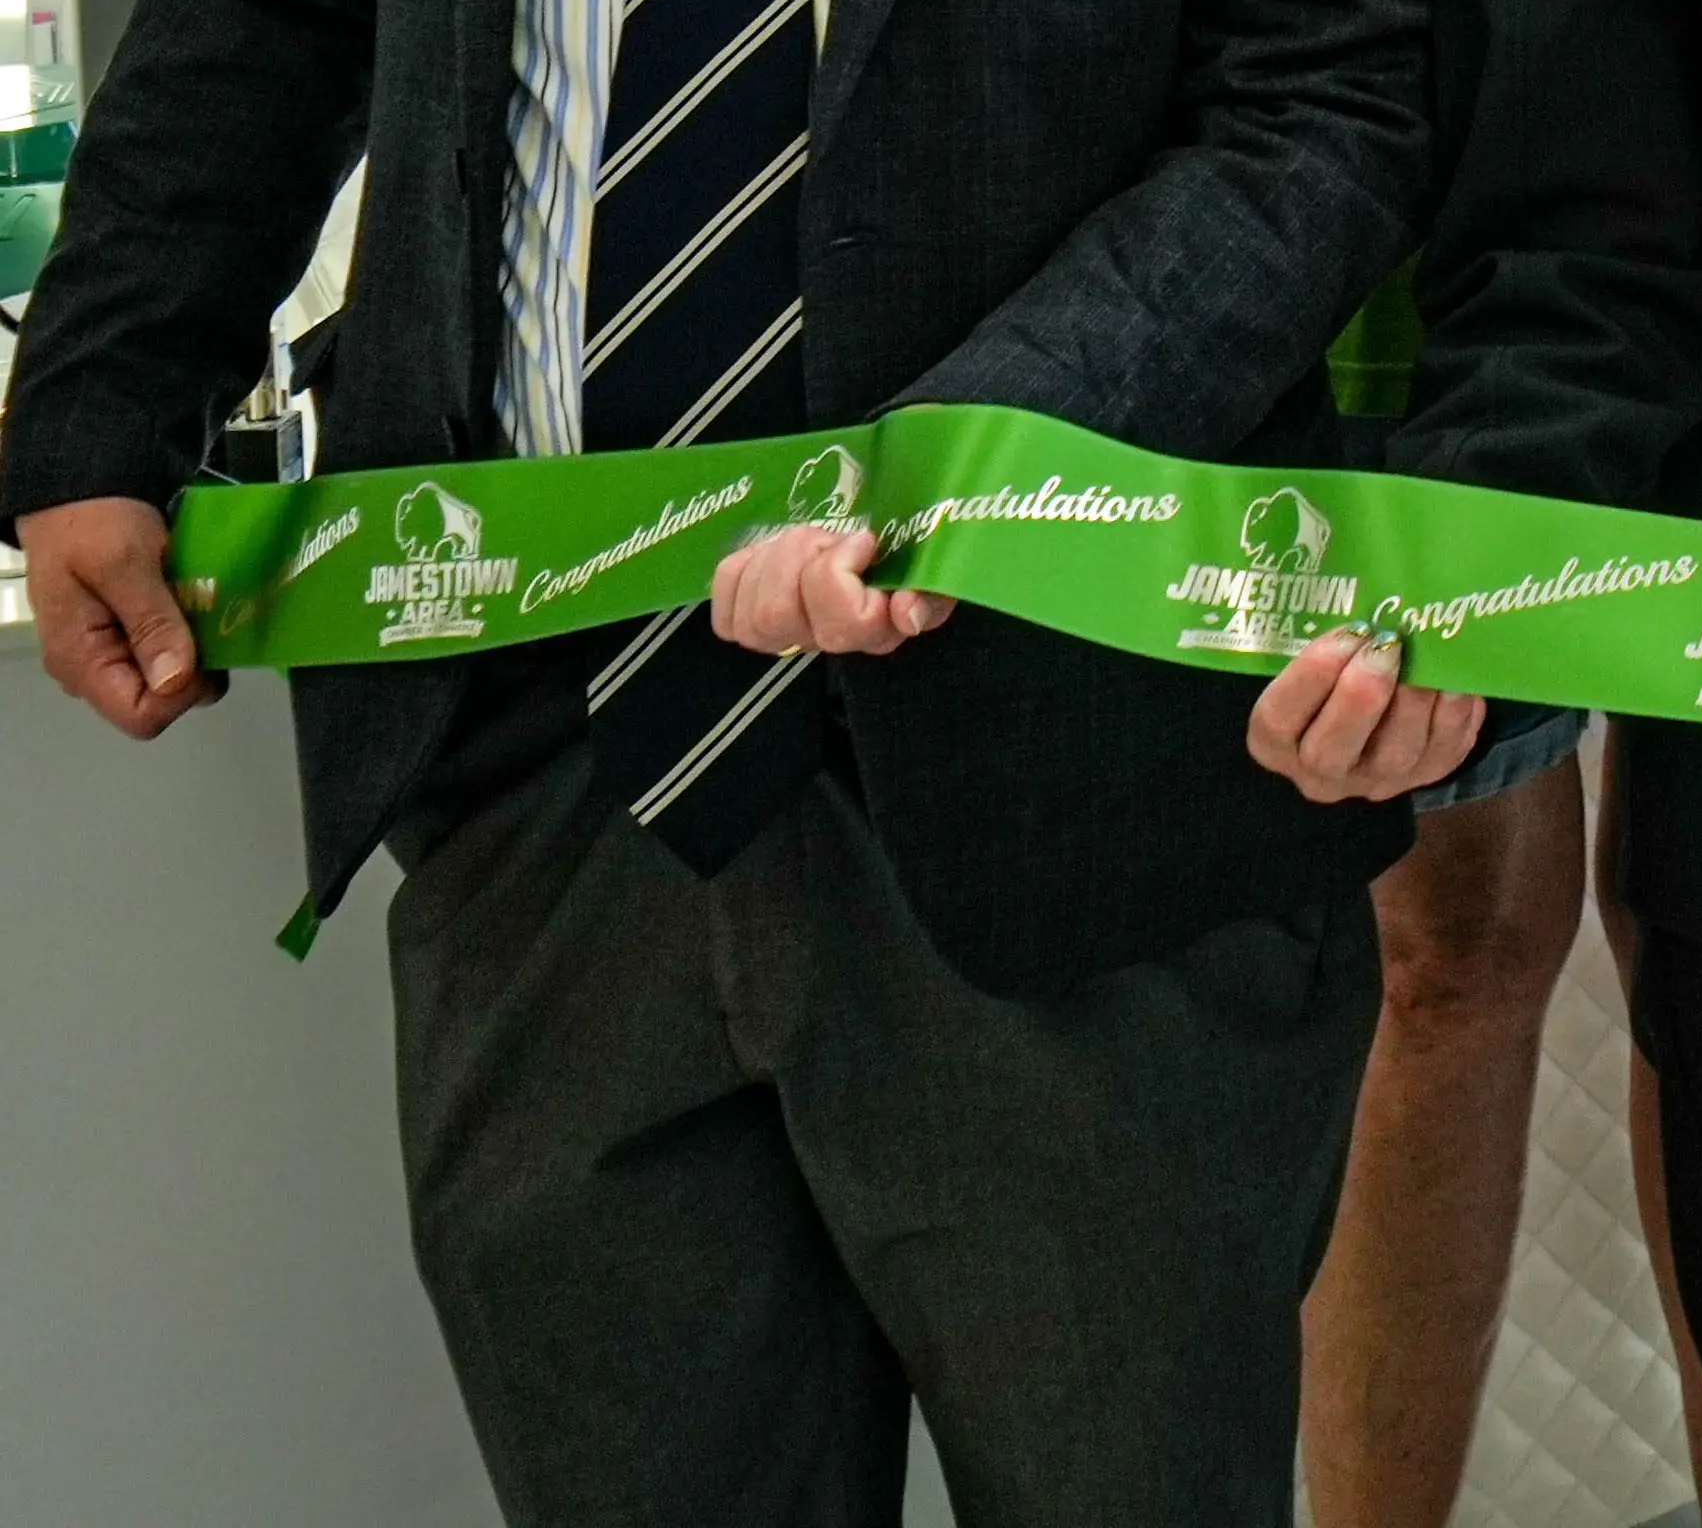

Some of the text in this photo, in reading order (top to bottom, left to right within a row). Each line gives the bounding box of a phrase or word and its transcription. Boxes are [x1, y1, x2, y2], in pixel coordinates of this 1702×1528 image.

[520, 474, 753, 615] Congratulations
[875, 475, 1182, 563] Congratulations
[365, 558, 518, 604] JAMESTOWN
[1166, 564, 1357, 616] JAMESTOWN
[1371, 554, 1697, 642] Congratulations
[400, 599, 464, 624] AREA
[1223, 609, 1295, 639] AREA
